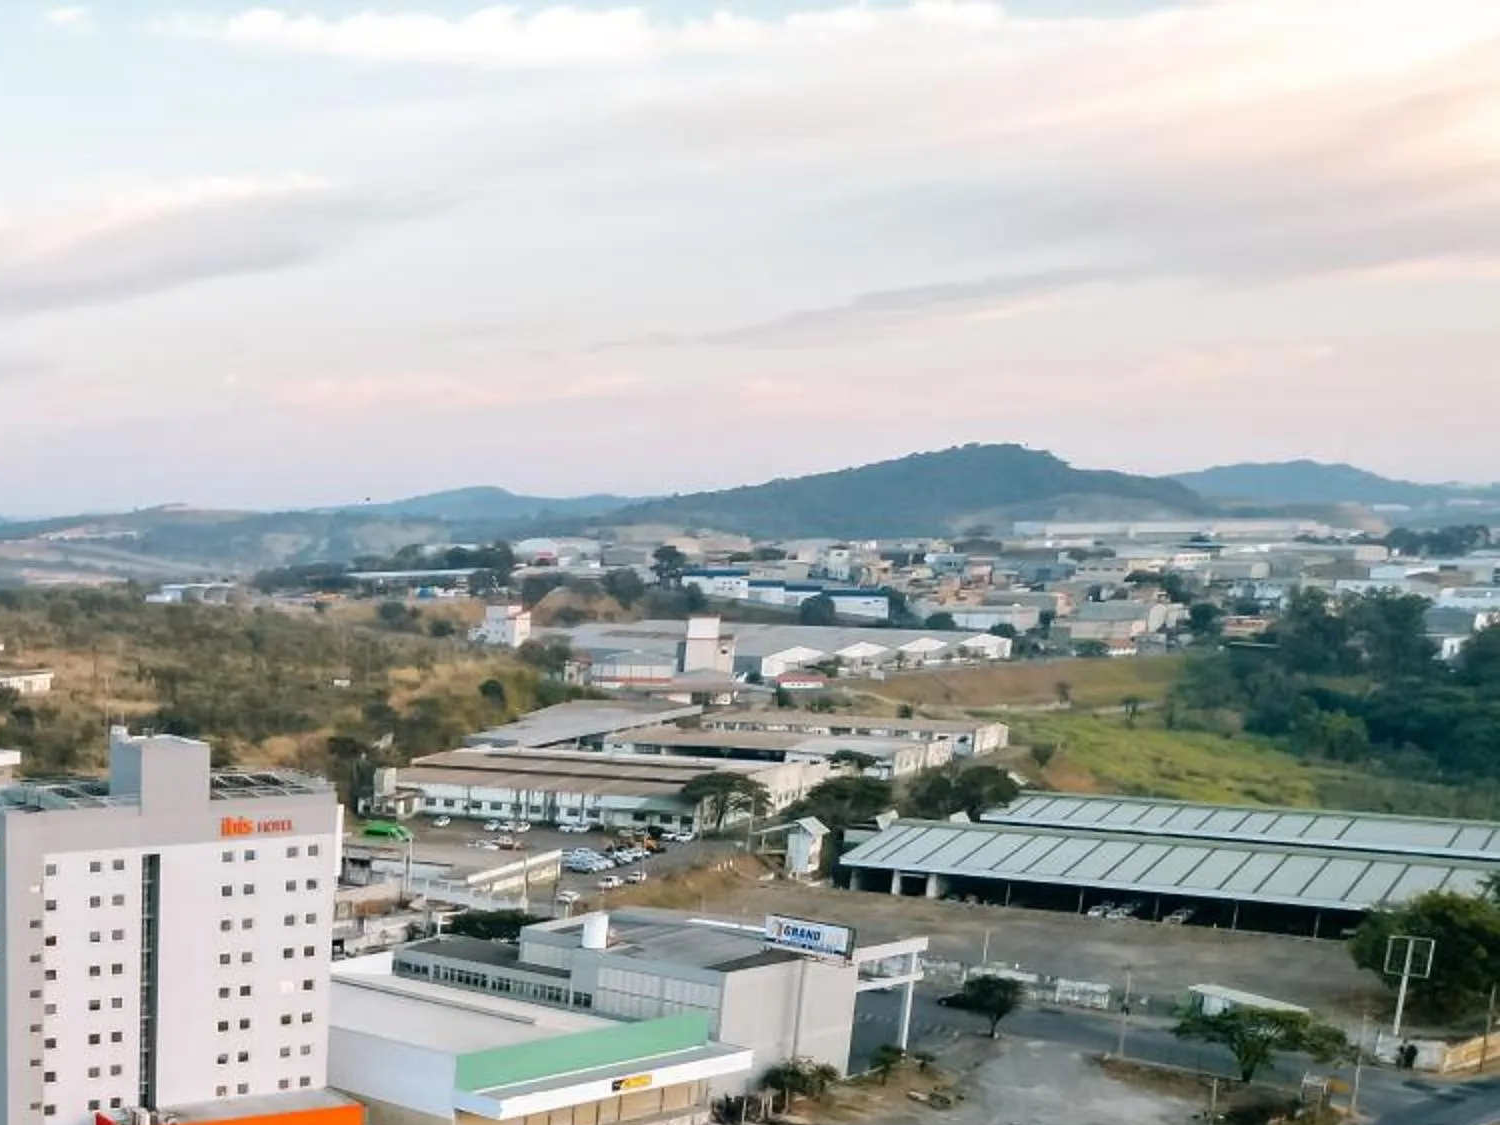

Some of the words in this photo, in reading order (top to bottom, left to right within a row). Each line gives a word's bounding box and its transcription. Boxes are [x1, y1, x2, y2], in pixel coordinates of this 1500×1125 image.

[221, 816, 253, 836] ibis
[257, 818, 293, 834] HOTEL
[783, 925, 821, 941] GRAND
